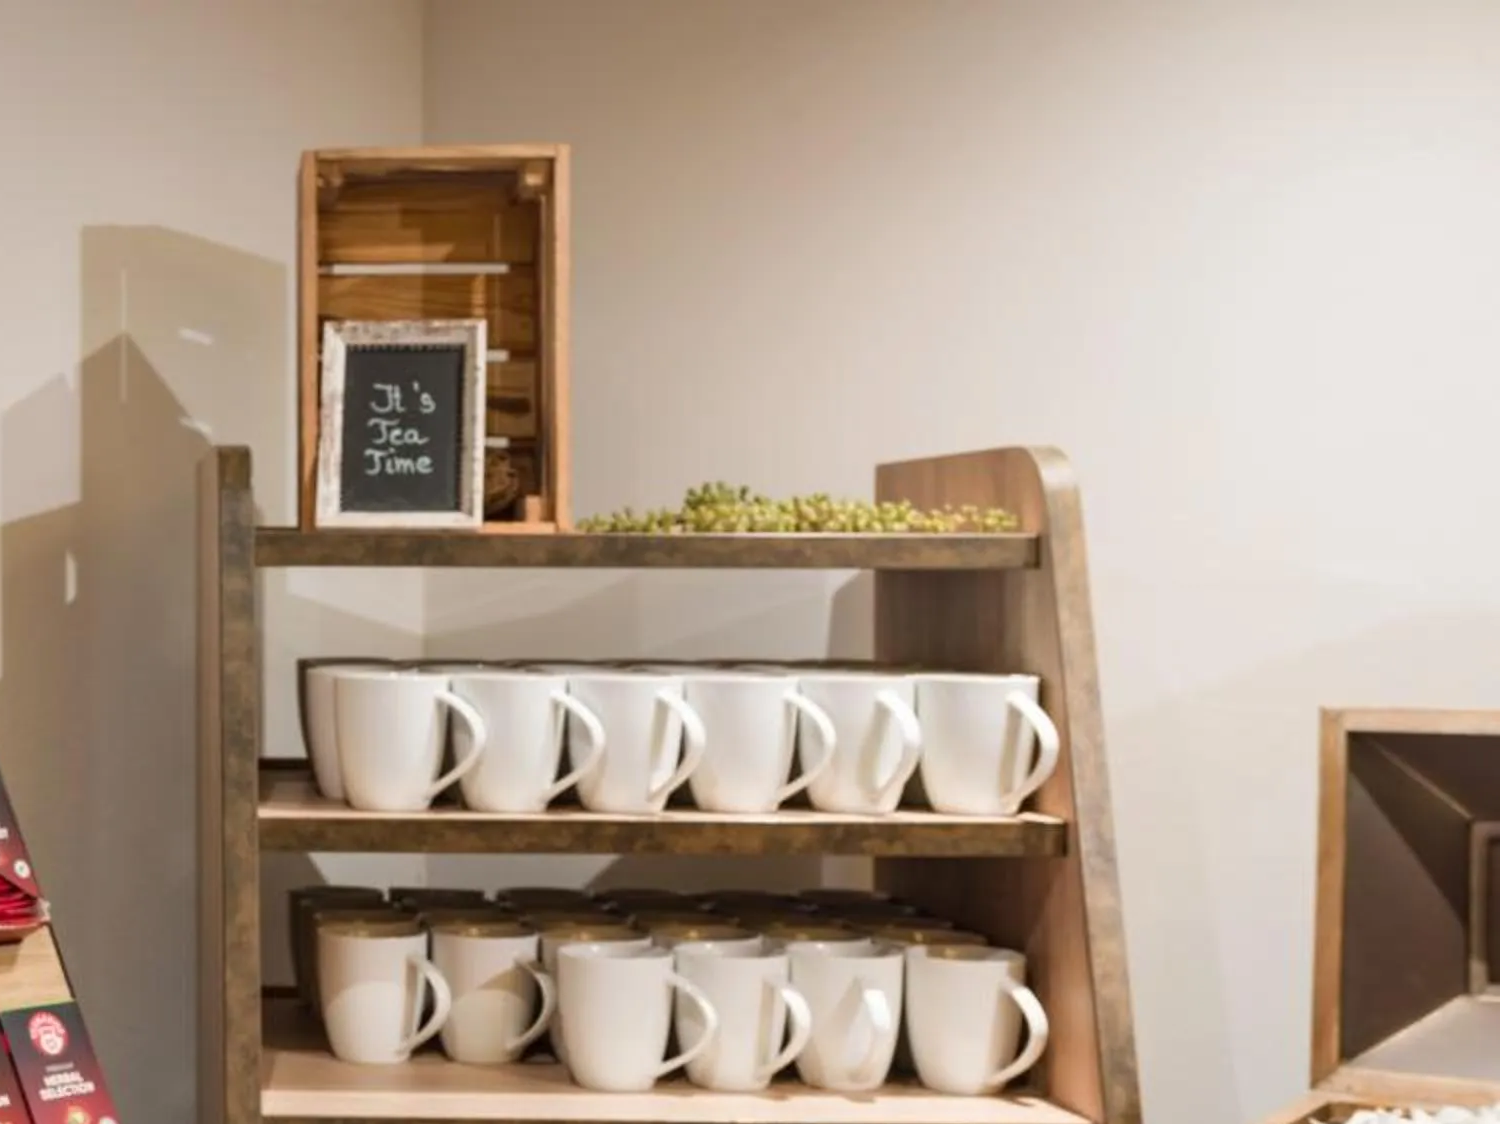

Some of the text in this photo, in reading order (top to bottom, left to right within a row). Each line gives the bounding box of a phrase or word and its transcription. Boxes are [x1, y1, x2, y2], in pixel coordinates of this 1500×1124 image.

[370, 381, 436, 413] It's
[367, 418, 430, 445] Tea
[364, 448, 434, 475] Time
